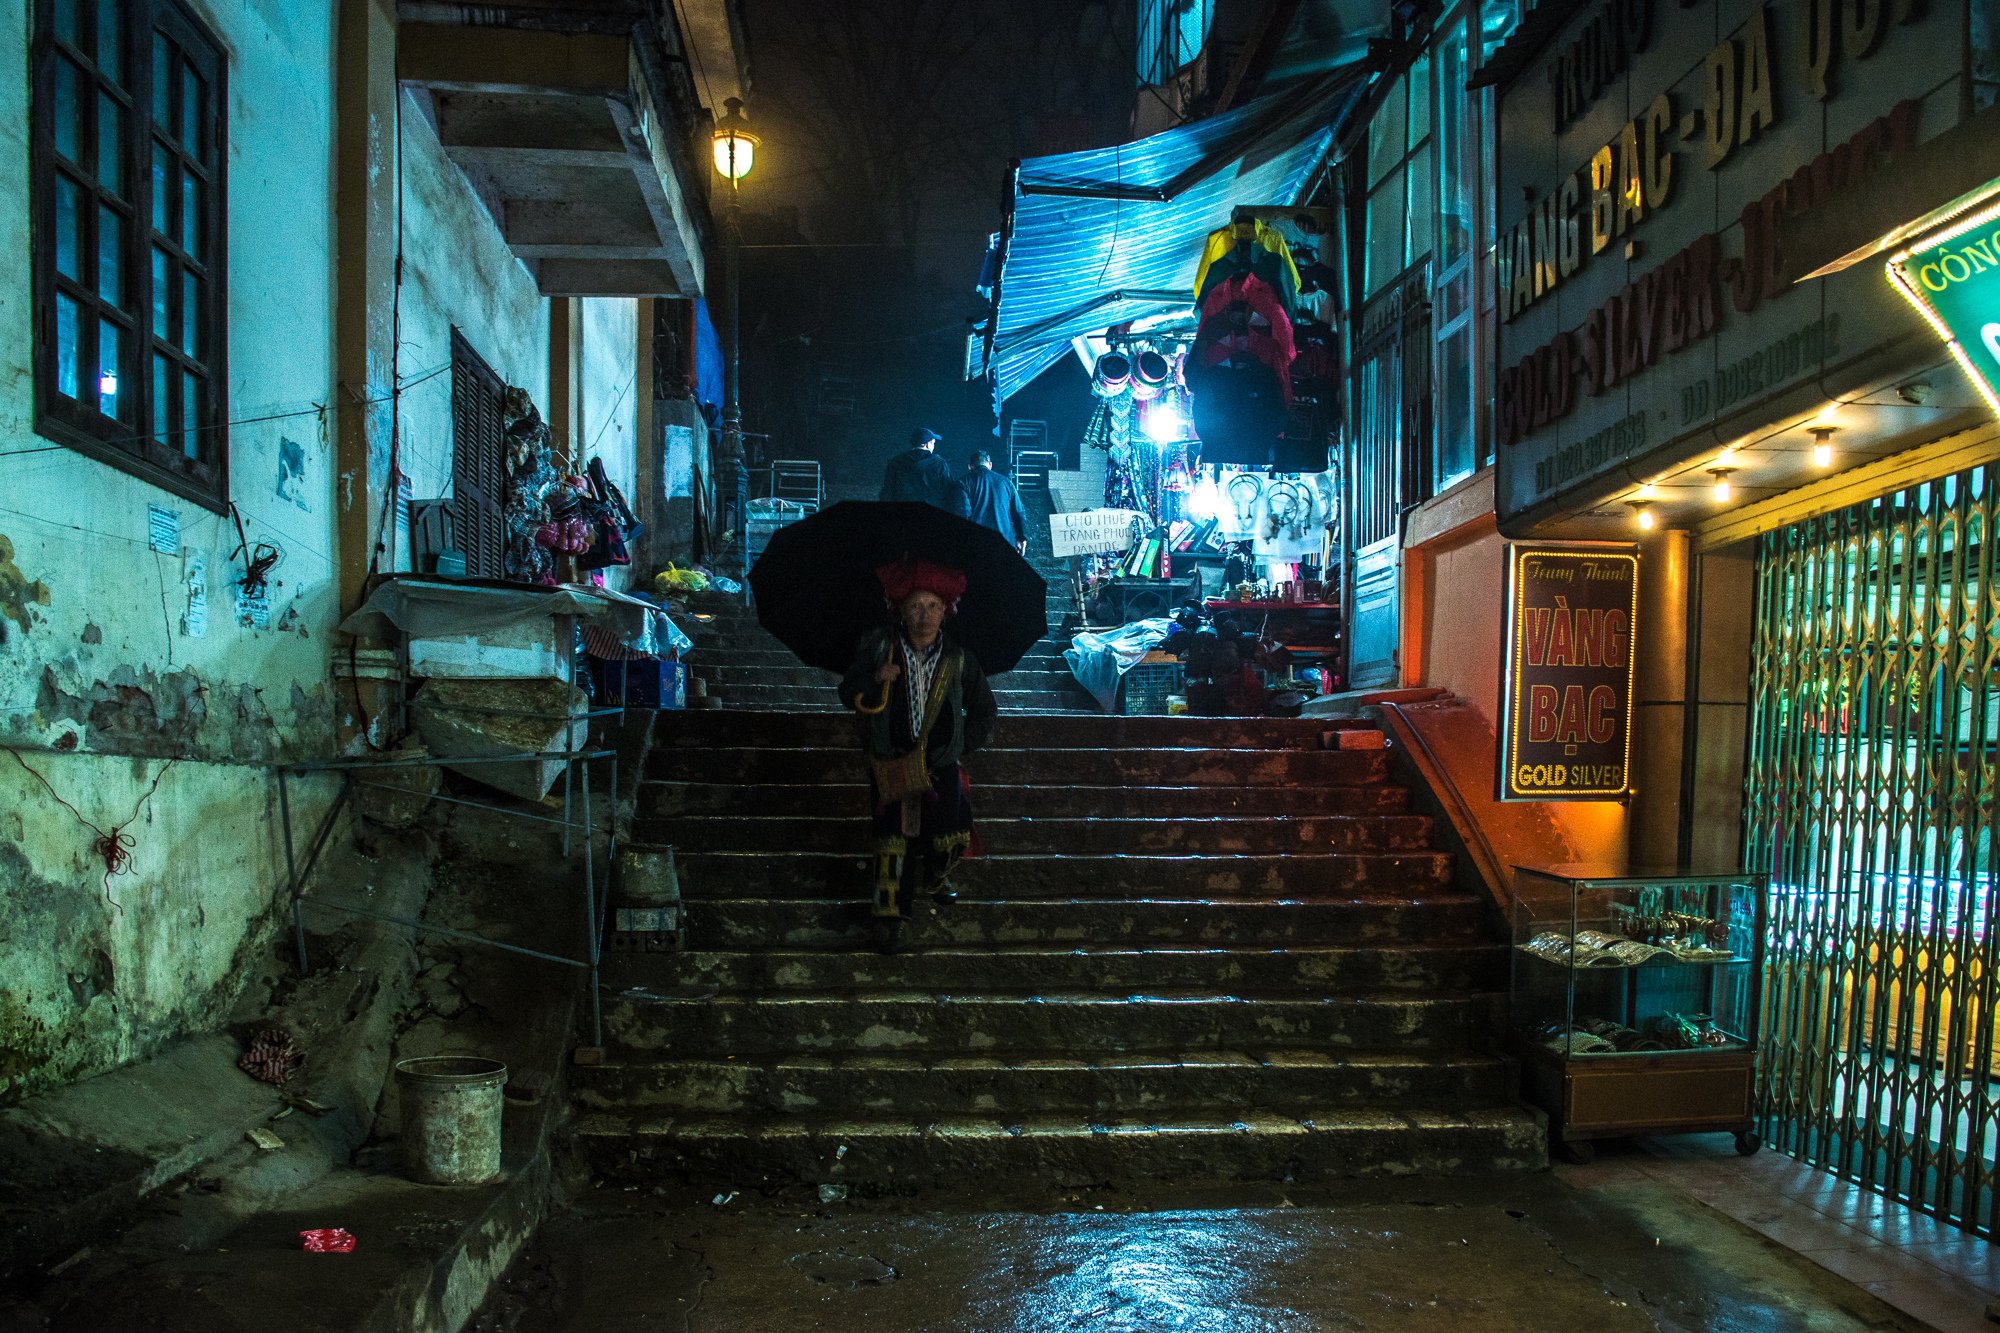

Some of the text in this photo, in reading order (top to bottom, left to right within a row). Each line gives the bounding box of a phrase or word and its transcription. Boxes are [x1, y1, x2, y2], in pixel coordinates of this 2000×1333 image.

[1497, 173, 1583, 324] VÀNG
[1065, 511, 1125, 527] CHO THUÊ
[1059, 529, 1100, 542] TRANG
[1527, 560, 1630, 583] Trung Thành
[1524, 595, 1628, 668] VÀNG
[1528, 684, 1617, 756] BẠC
[1518, 764, 1622, 786] GOLD SILVER
